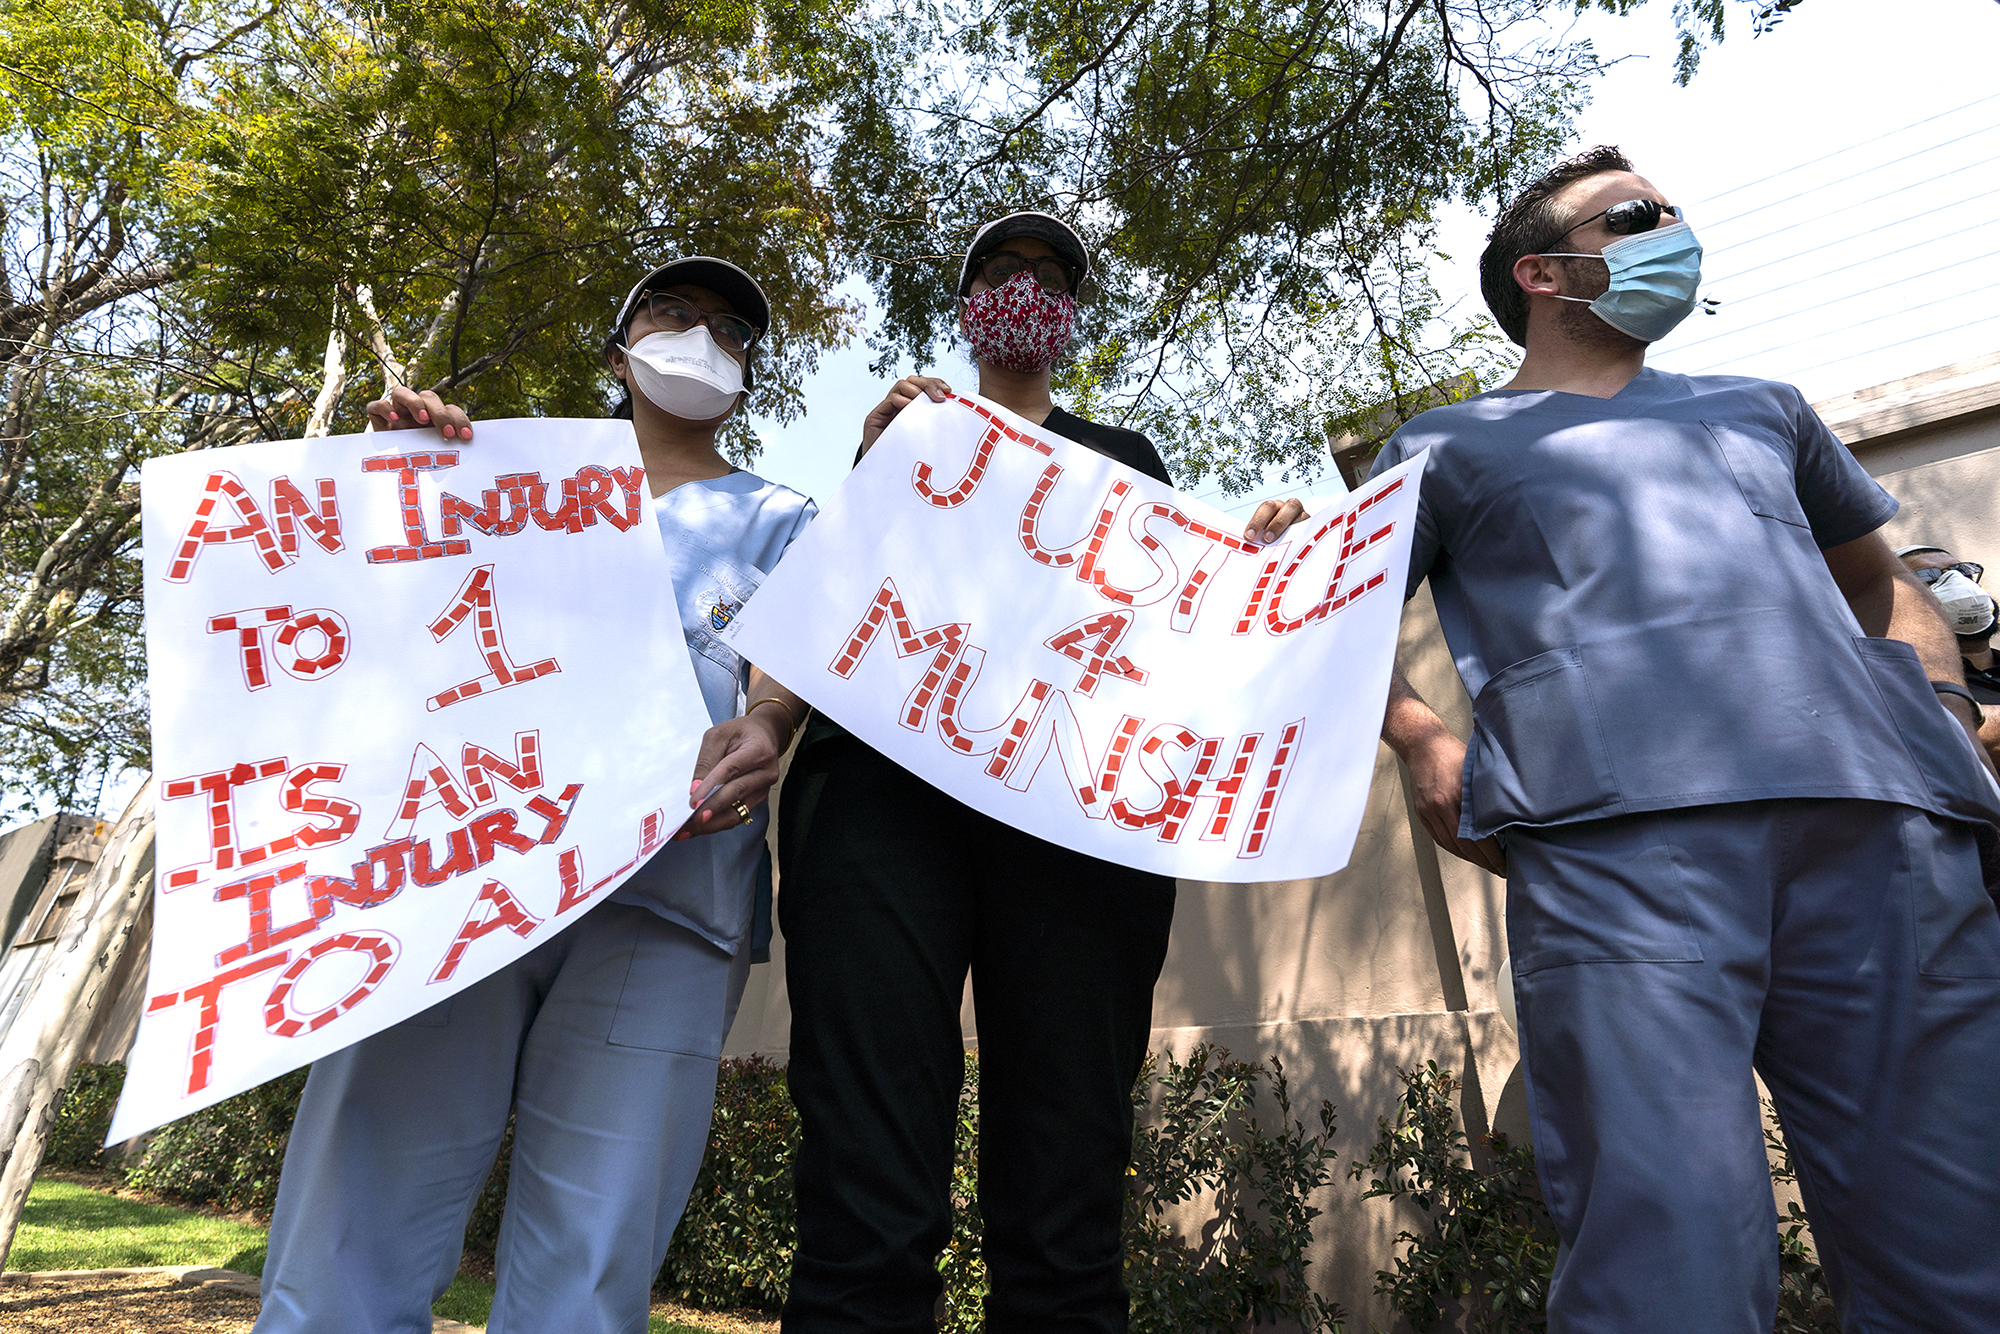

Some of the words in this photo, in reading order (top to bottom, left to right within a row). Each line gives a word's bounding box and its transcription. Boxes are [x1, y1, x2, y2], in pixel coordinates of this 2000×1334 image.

[163, 470, 346, 584] AN
[361, 450, 646, 564] INJURY
[911, 393, 1408, 637] JUSTICE
[206, 604, 351, 692] TO
[426, 563, 562, 712] 1
[1043, 609, 1149, 698] 4
[1958, 616, 1978, 625] 3M
[829, 577, 1306, 859] MUNSHI
[161, 757, 360, 894] IS
[384, 729, 543, 842] AN
[213, 783, 584, 968] INJURY
[146, 929, 402, 1099] TO
[426, 808, 680, 986] ALL
